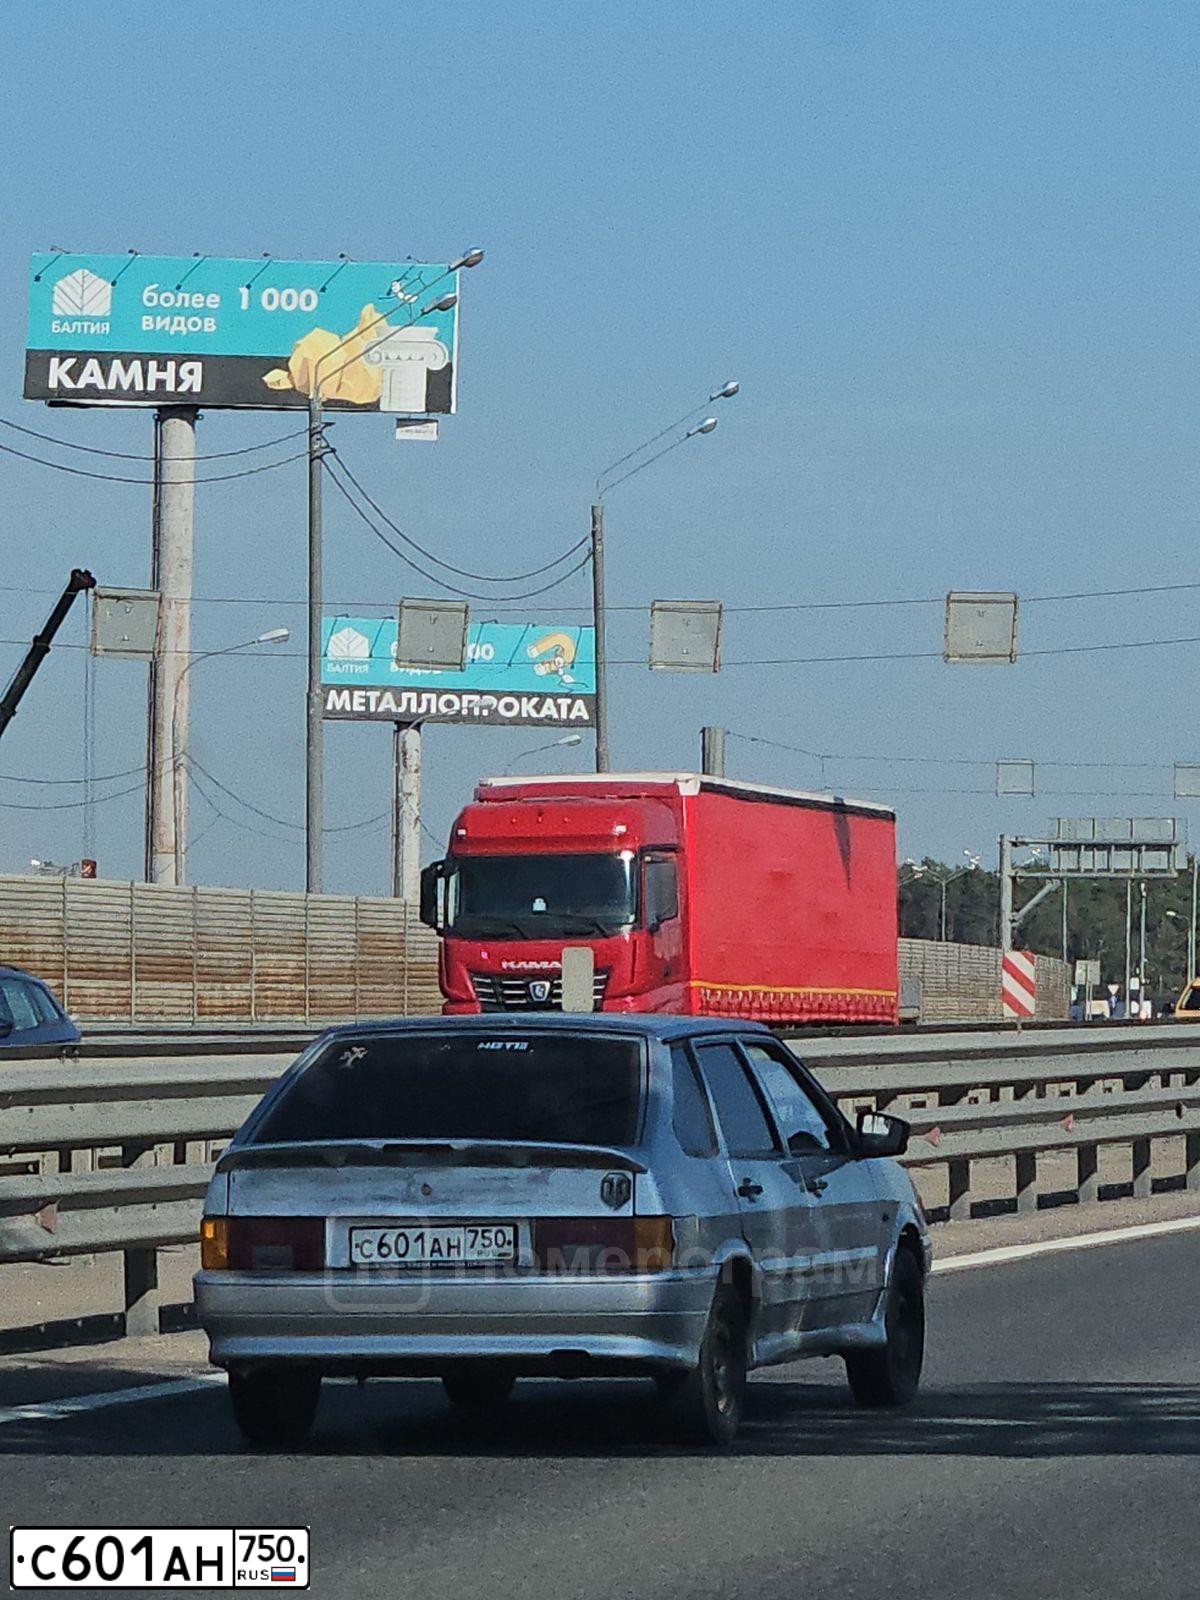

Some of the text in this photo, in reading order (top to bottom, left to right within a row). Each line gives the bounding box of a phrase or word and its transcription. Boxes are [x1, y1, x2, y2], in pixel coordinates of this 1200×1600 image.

[142, 284, 319, 312] более 1 000
[51, 320, 111, 335] БАЛТИЯ
[142, 315, 217, 336] видов
[48, 357, 203, 393] КАМНЯ
[326, 689, 590, 721] МЕТАЛЛОПРОКАТА
[359, 1228, 507, 1259] С601АН 750
